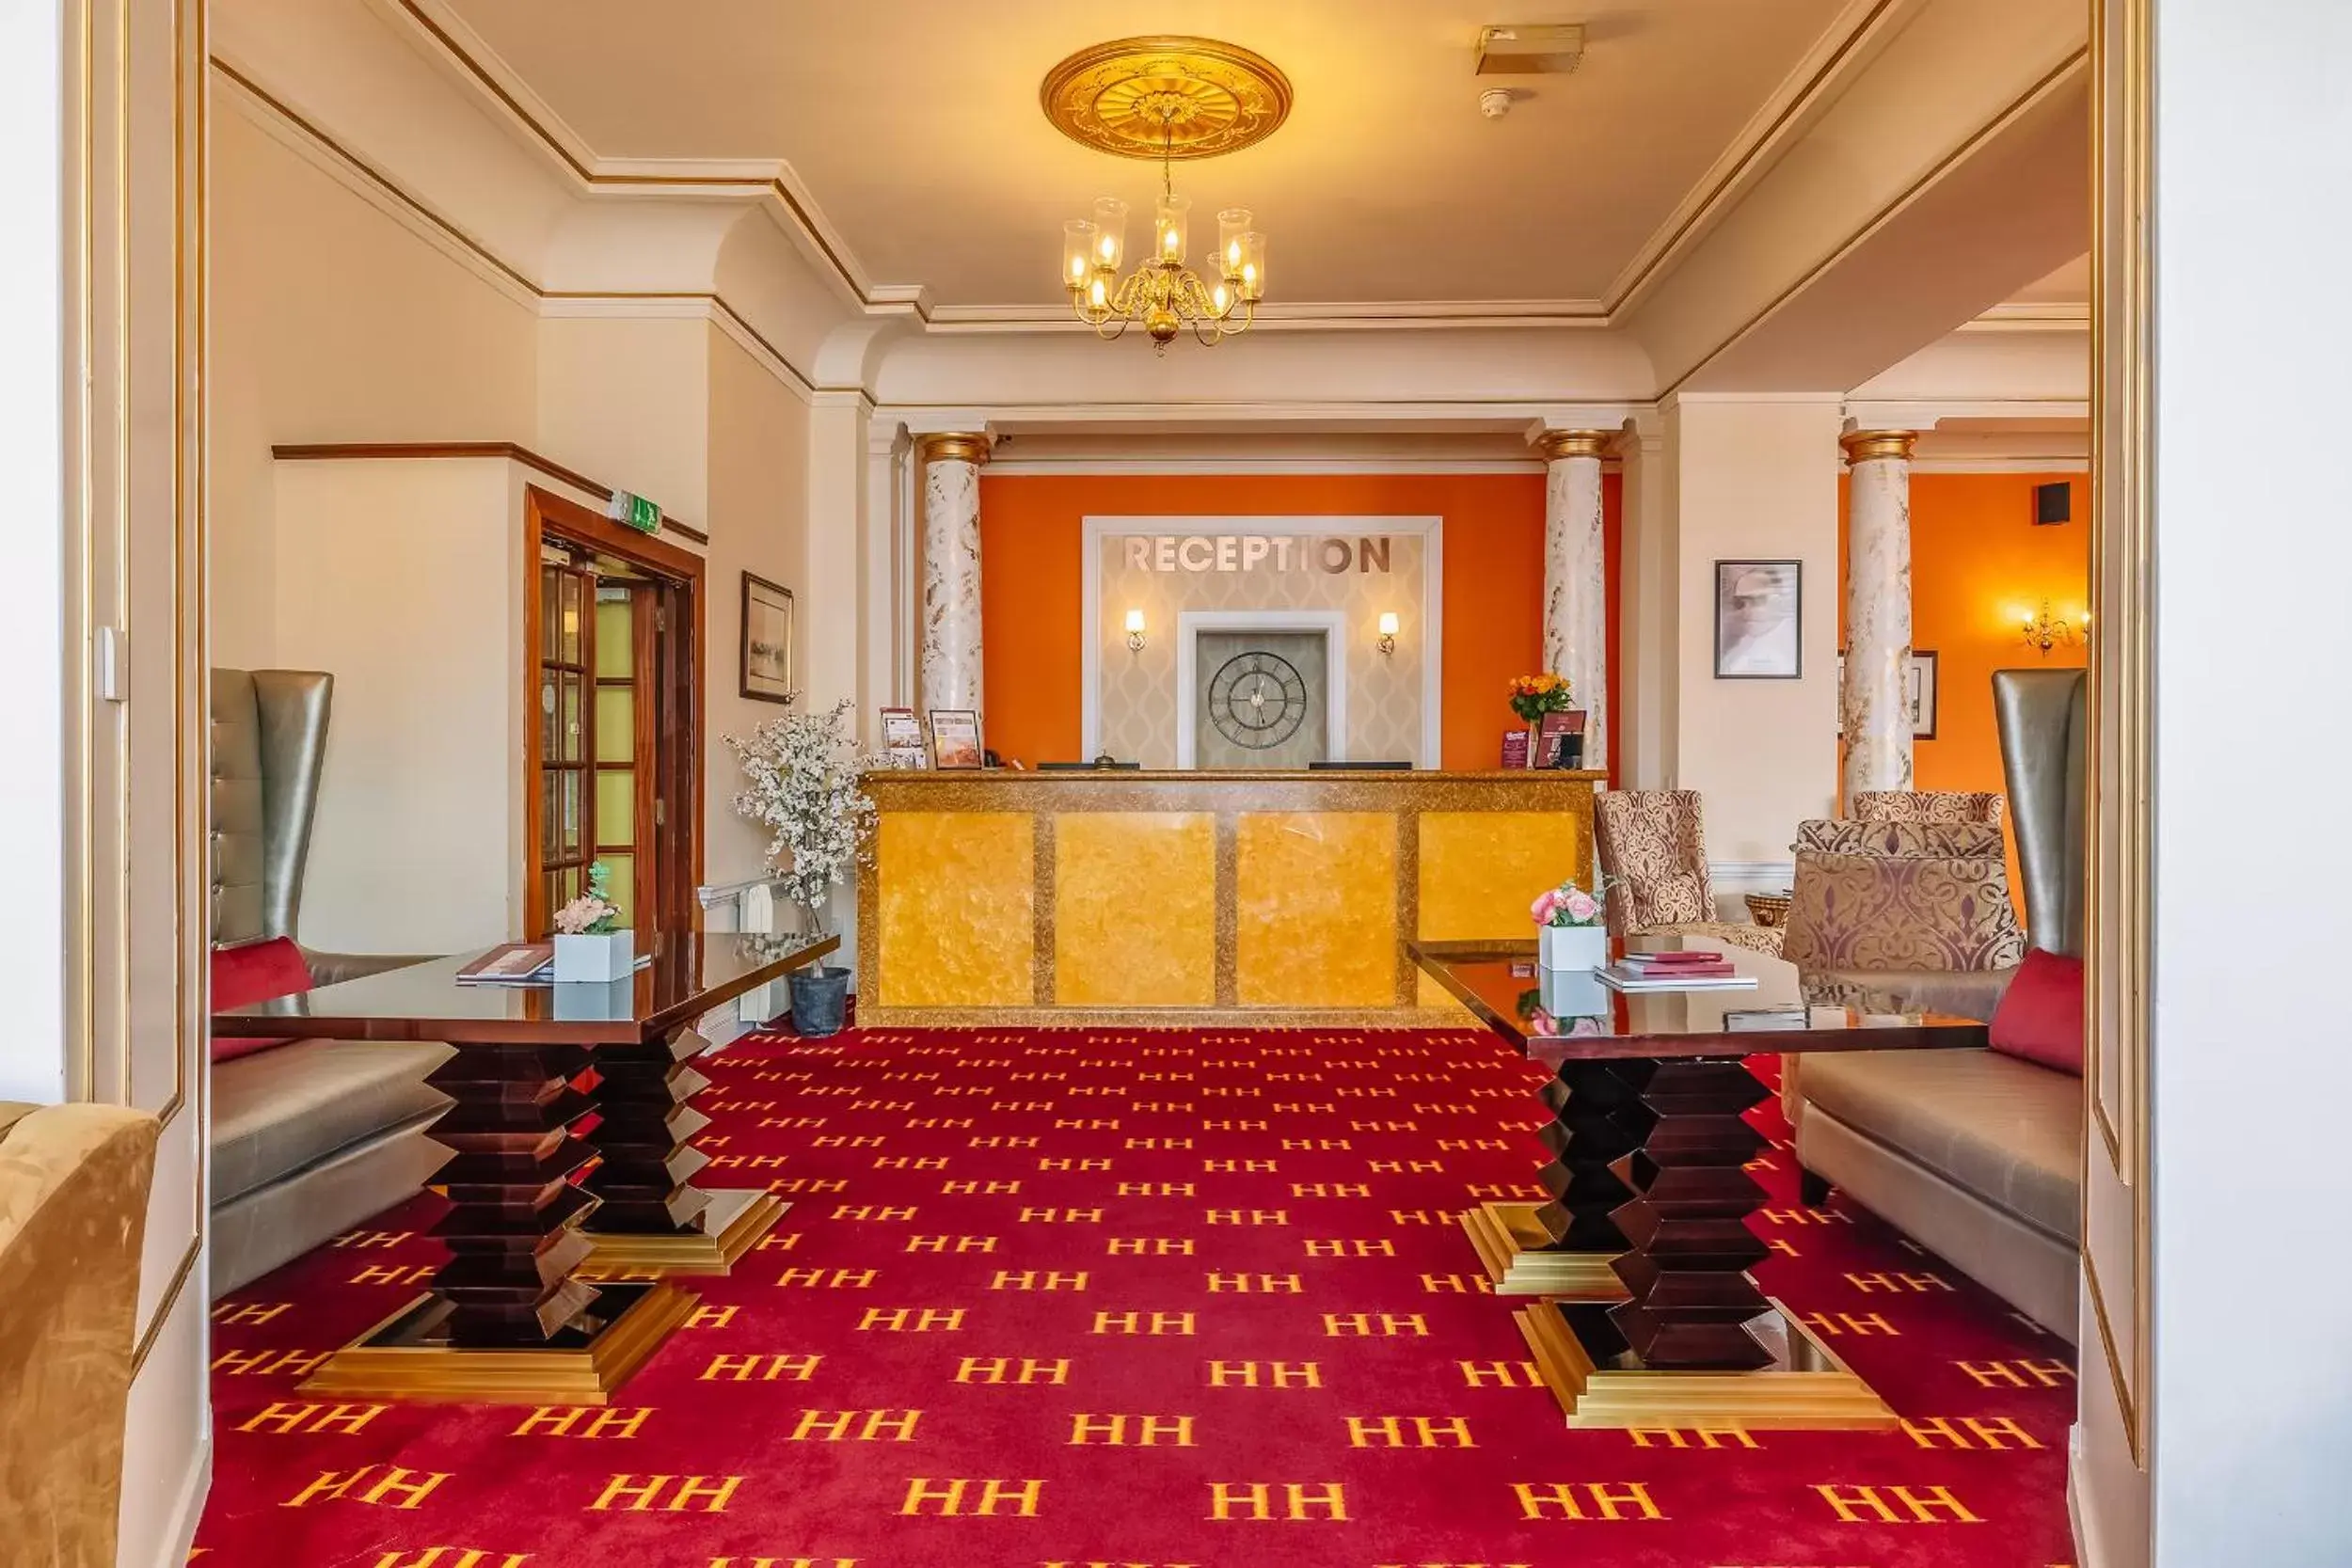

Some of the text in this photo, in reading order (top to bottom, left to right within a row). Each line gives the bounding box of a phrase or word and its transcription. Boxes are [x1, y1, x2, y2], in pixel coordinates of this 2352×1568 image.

[1123, 535, 1391, 574] RECEPTION
[1117, 1181, 1195, 1196] HH
[829, 1205, 919, 1221] HH
[1018, 1207, 1104, 1223] HH
[1205, 1209, 1290, 1226] HH
[904, 1235, 999, 1253] HH
[1106, 1238, 1195, 1256] HH
[1303, 1239, 1396, 1257] HH
[775, 1267, 879, 1288] HH
[989, 1271, 1089, 1291] HH
[1206, 1273, 1304, 1293] HH
[856, 1307, 967, 1332] HH
[1090, 1311, 1197, 1336] HH
[1322, 1313, 1430, 1337] HH
[697, 1354, 824, 1381] HH
[954, 1356, 1072, 1386] HH
[1208, 1360, 1324, 1389] HH
[233, 1402, 394, 1435] HH
[510, 1405, 656, 1439] HH
[787, 1408, 925, 1442] HH
[1066, 1413, 1199, 1447] HH
[1344, 1416, 1478, 1449] HH
[1899, 1416, 2048, 1449] HH
[278, 1465, 453, 1510] HH
[587, 1473, 746, 1513] HH
[897, 1477, 1046, 1517] HH
[1208, 1482, 1350, 1522] HH
[1509, 1482, 1665, 1520] HH
[1811, 1483, 1983, 1524] HH
